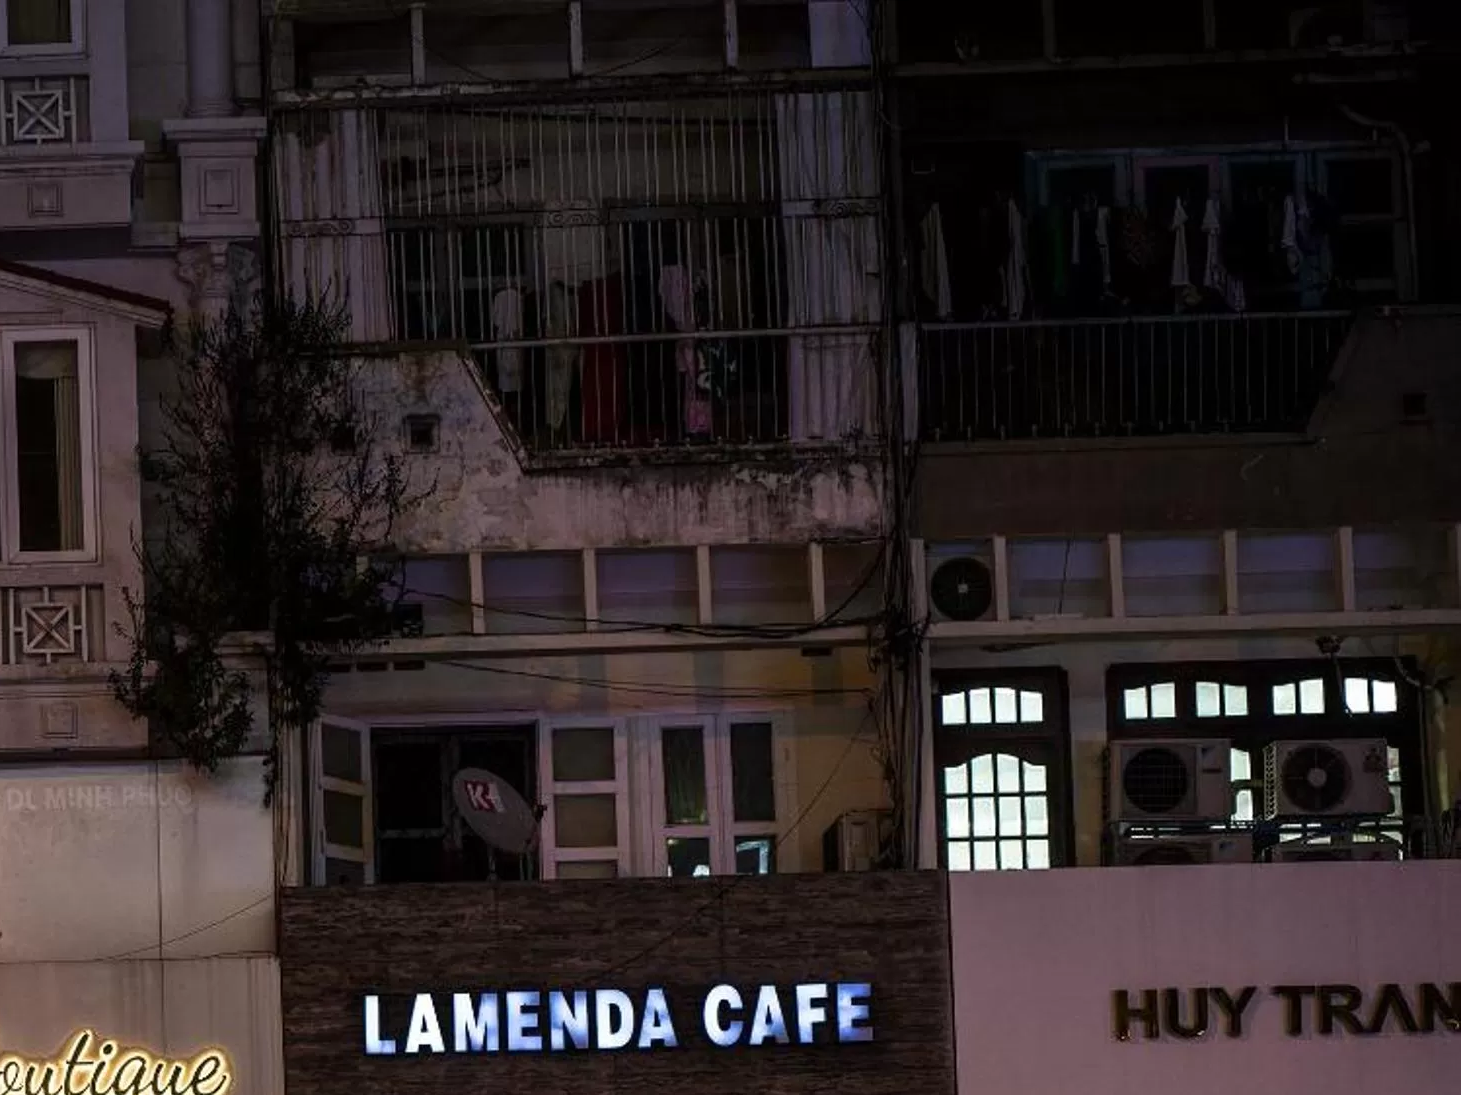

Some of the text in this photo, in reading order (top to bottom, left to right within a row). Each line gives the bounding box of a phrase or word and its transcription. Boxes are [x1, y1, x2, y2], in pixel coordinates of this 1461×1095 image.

[363, 982, 875, 1055] LAMENDA CAFE
[1110, 985, 1257, 1042] HUY
